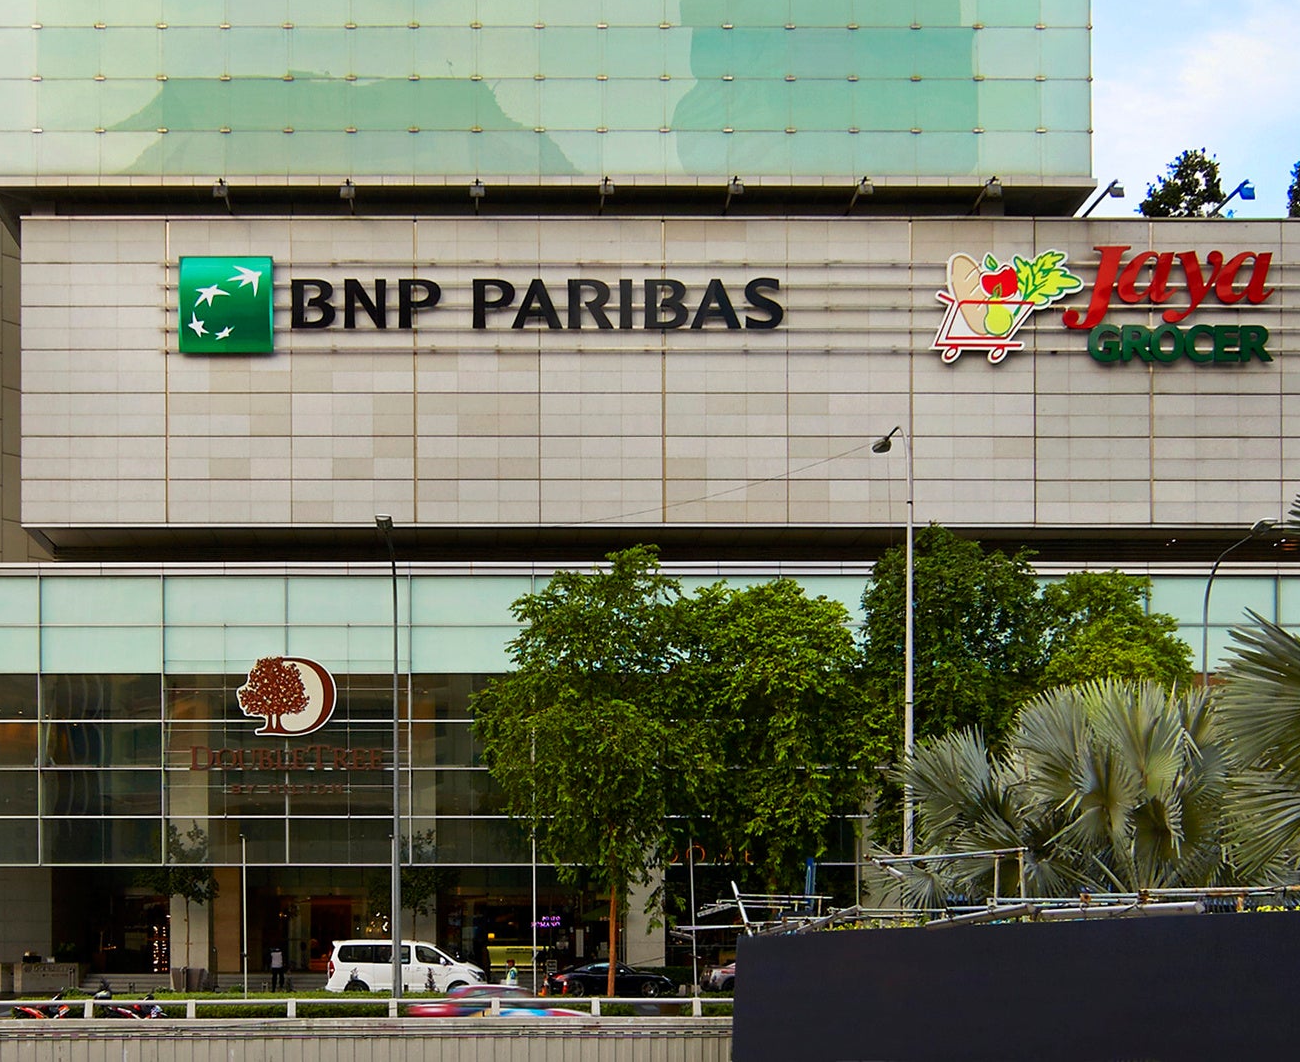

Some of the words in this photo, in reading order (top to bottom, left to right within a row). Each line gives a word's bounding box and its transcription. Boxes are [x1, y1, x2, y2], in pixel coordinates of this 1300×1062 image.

[290, 278, 442, 330] BNP
[472, 277, 785, 330] PARIBAS
[1061, 245, 1275, 330] Jaya
[1087, 323, 1274, 364] GROCER
